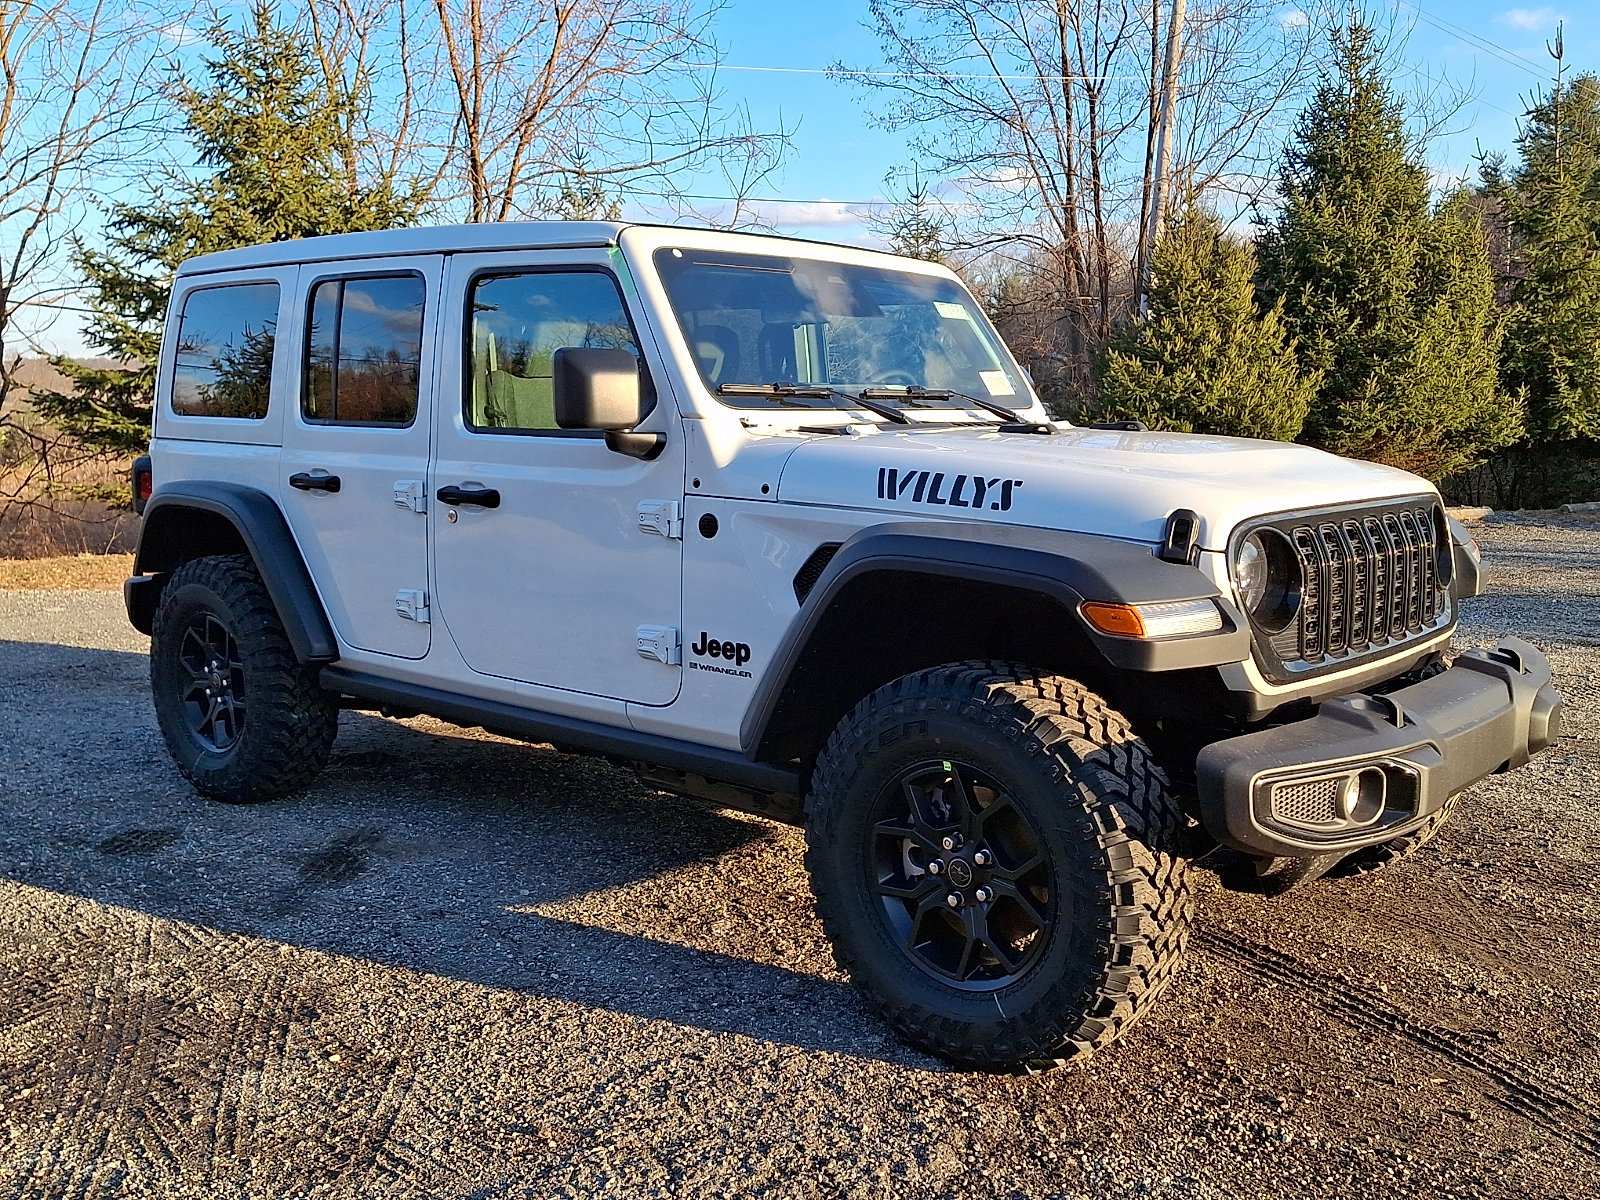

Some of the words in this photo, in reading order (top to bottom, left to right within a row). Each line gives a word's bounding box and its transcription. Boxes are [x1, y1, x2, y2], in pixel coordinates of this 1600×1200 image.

[877, 467, 1024, 511] WILLYS
[691, 631, 751, 667] Jeep
[698, 663, 753, 679] WRANGLER
